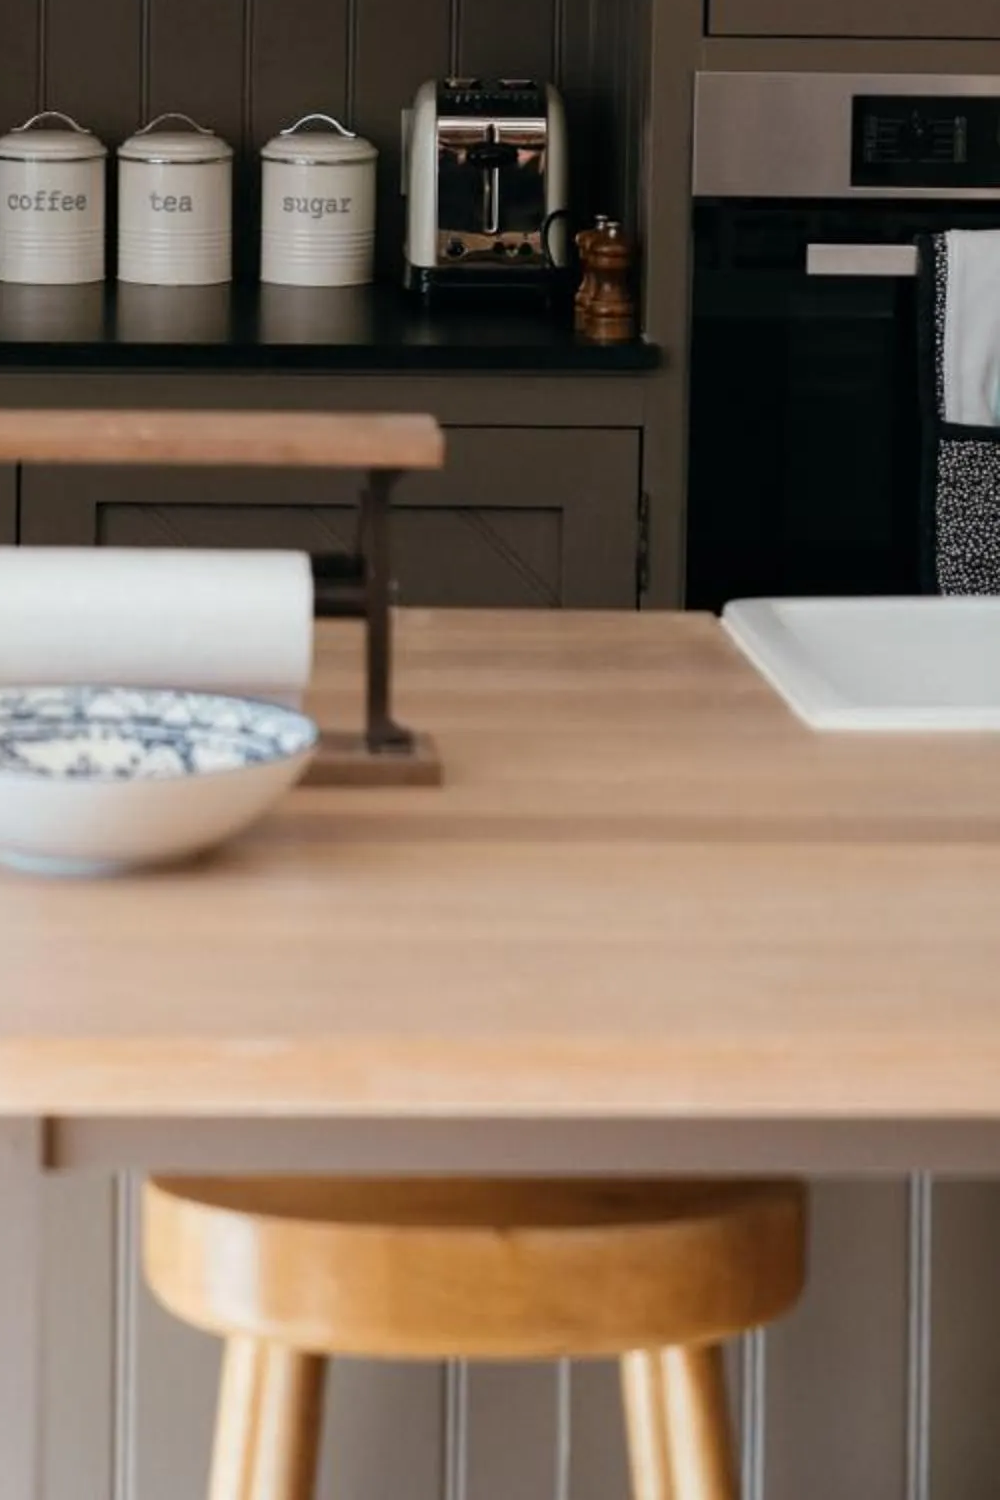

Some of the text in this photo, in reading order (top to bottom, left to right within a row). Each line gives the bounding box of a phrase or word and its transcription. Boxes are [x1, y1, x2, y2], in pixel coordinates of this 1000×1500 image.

[7, 190, 87, 211] coffee
[149, 191, 192, 212] tea
[282, 196, 351, 218] sugar
